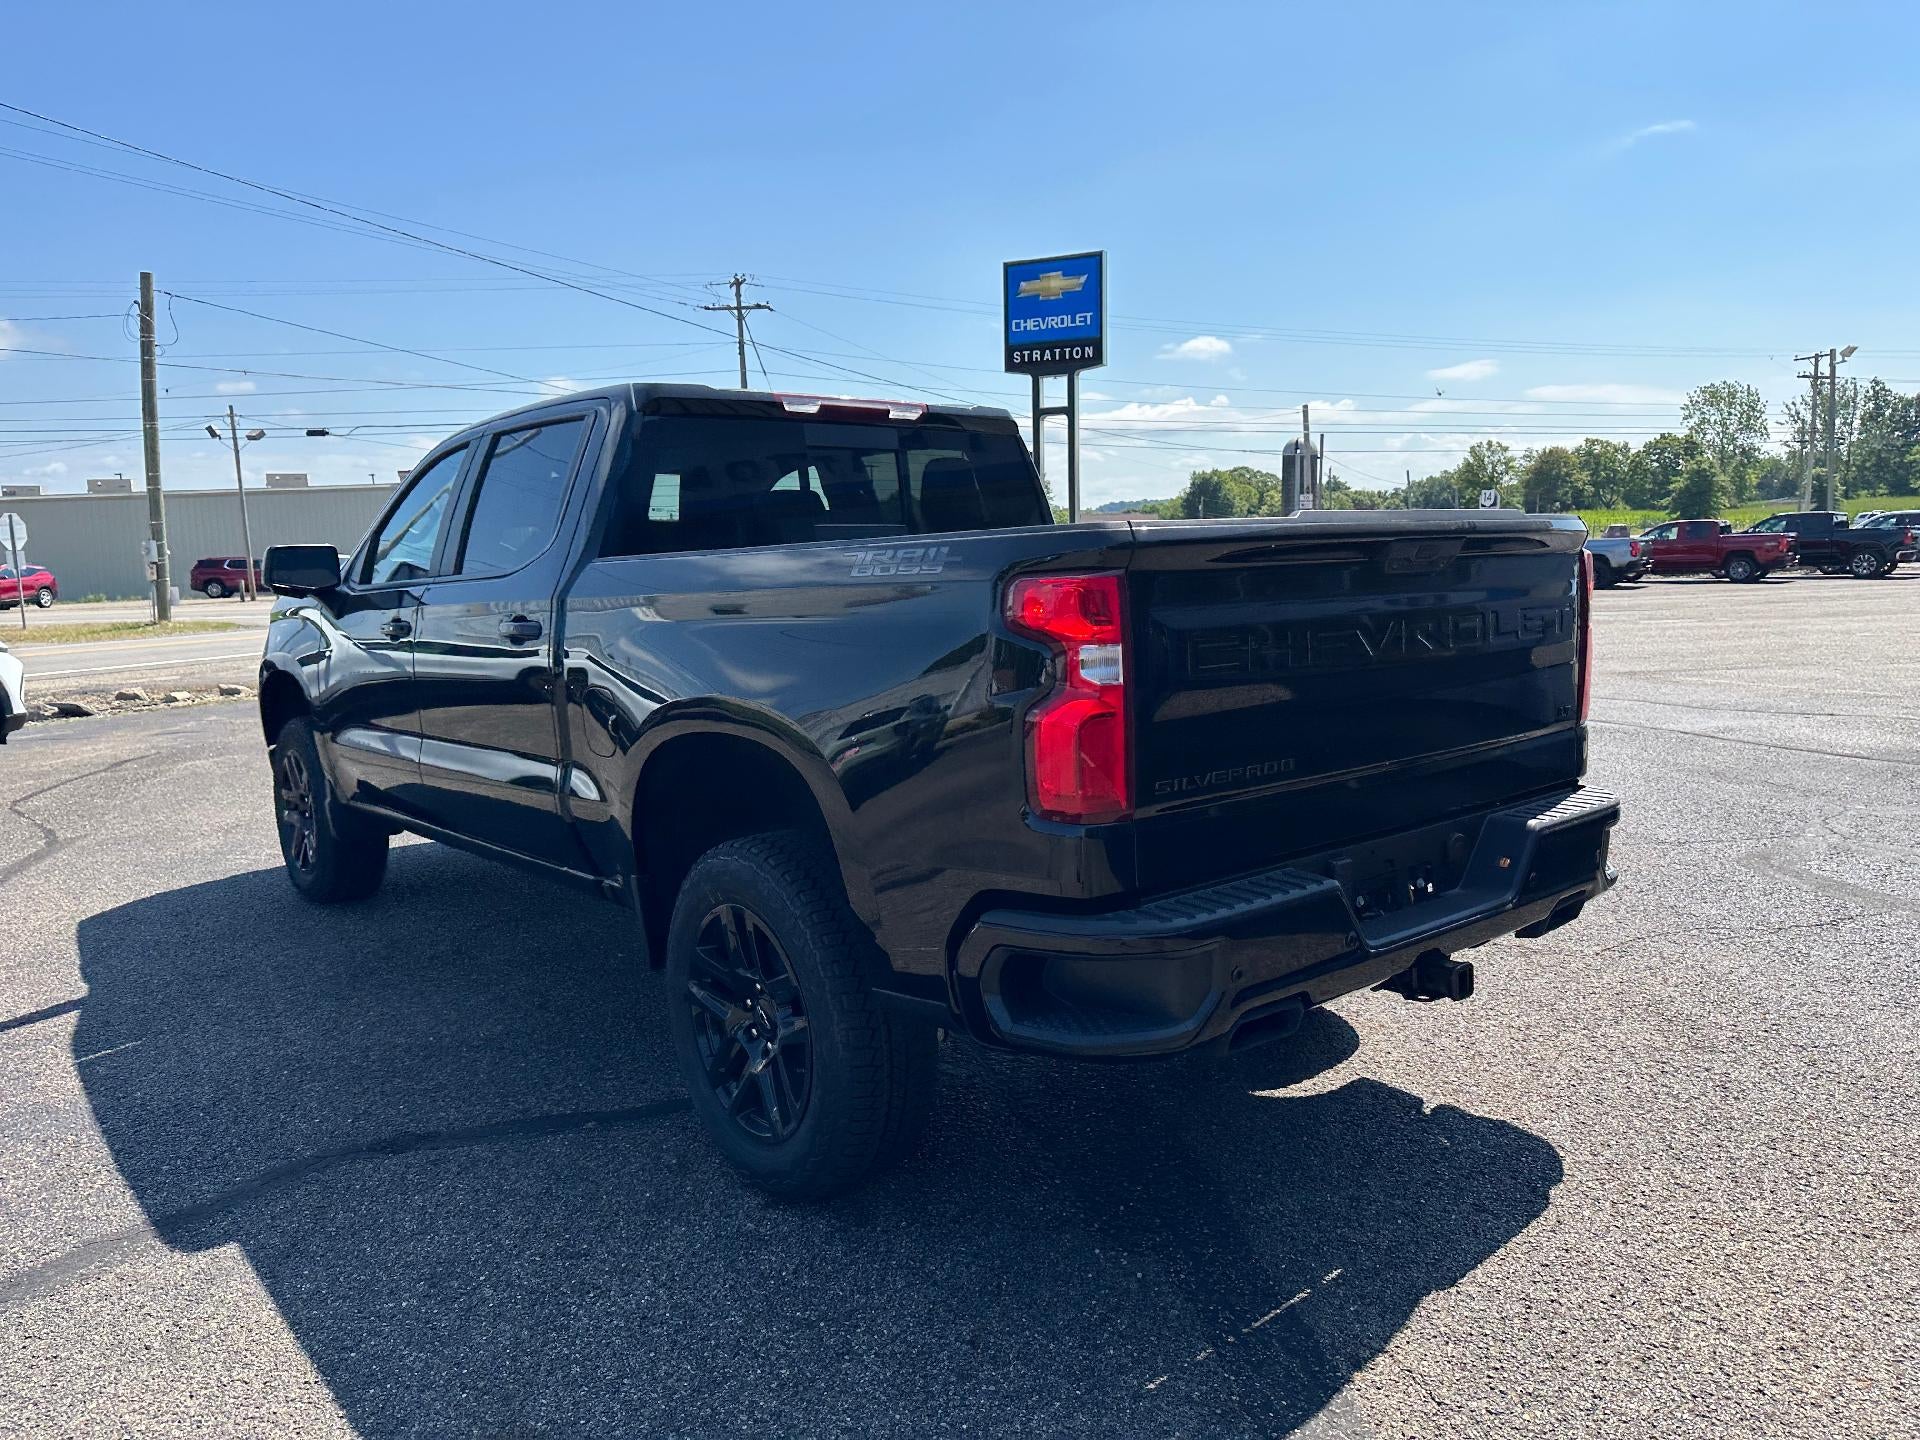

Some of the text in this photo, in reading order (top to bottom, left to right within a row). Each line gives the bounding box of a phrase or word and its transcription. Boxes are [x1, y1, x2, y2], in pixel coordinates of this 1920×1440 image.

[1011, 312, 1093, 332] CHEVROLET
[1013, 346, 1094, 363] STRATTON
[1483, 491, 1492, 503] 14
[843, 546, 962, 564] TRAIL
[850, 561, 944, 577] BOSS
[1154, 758, 1296, 796] SILVERADO
